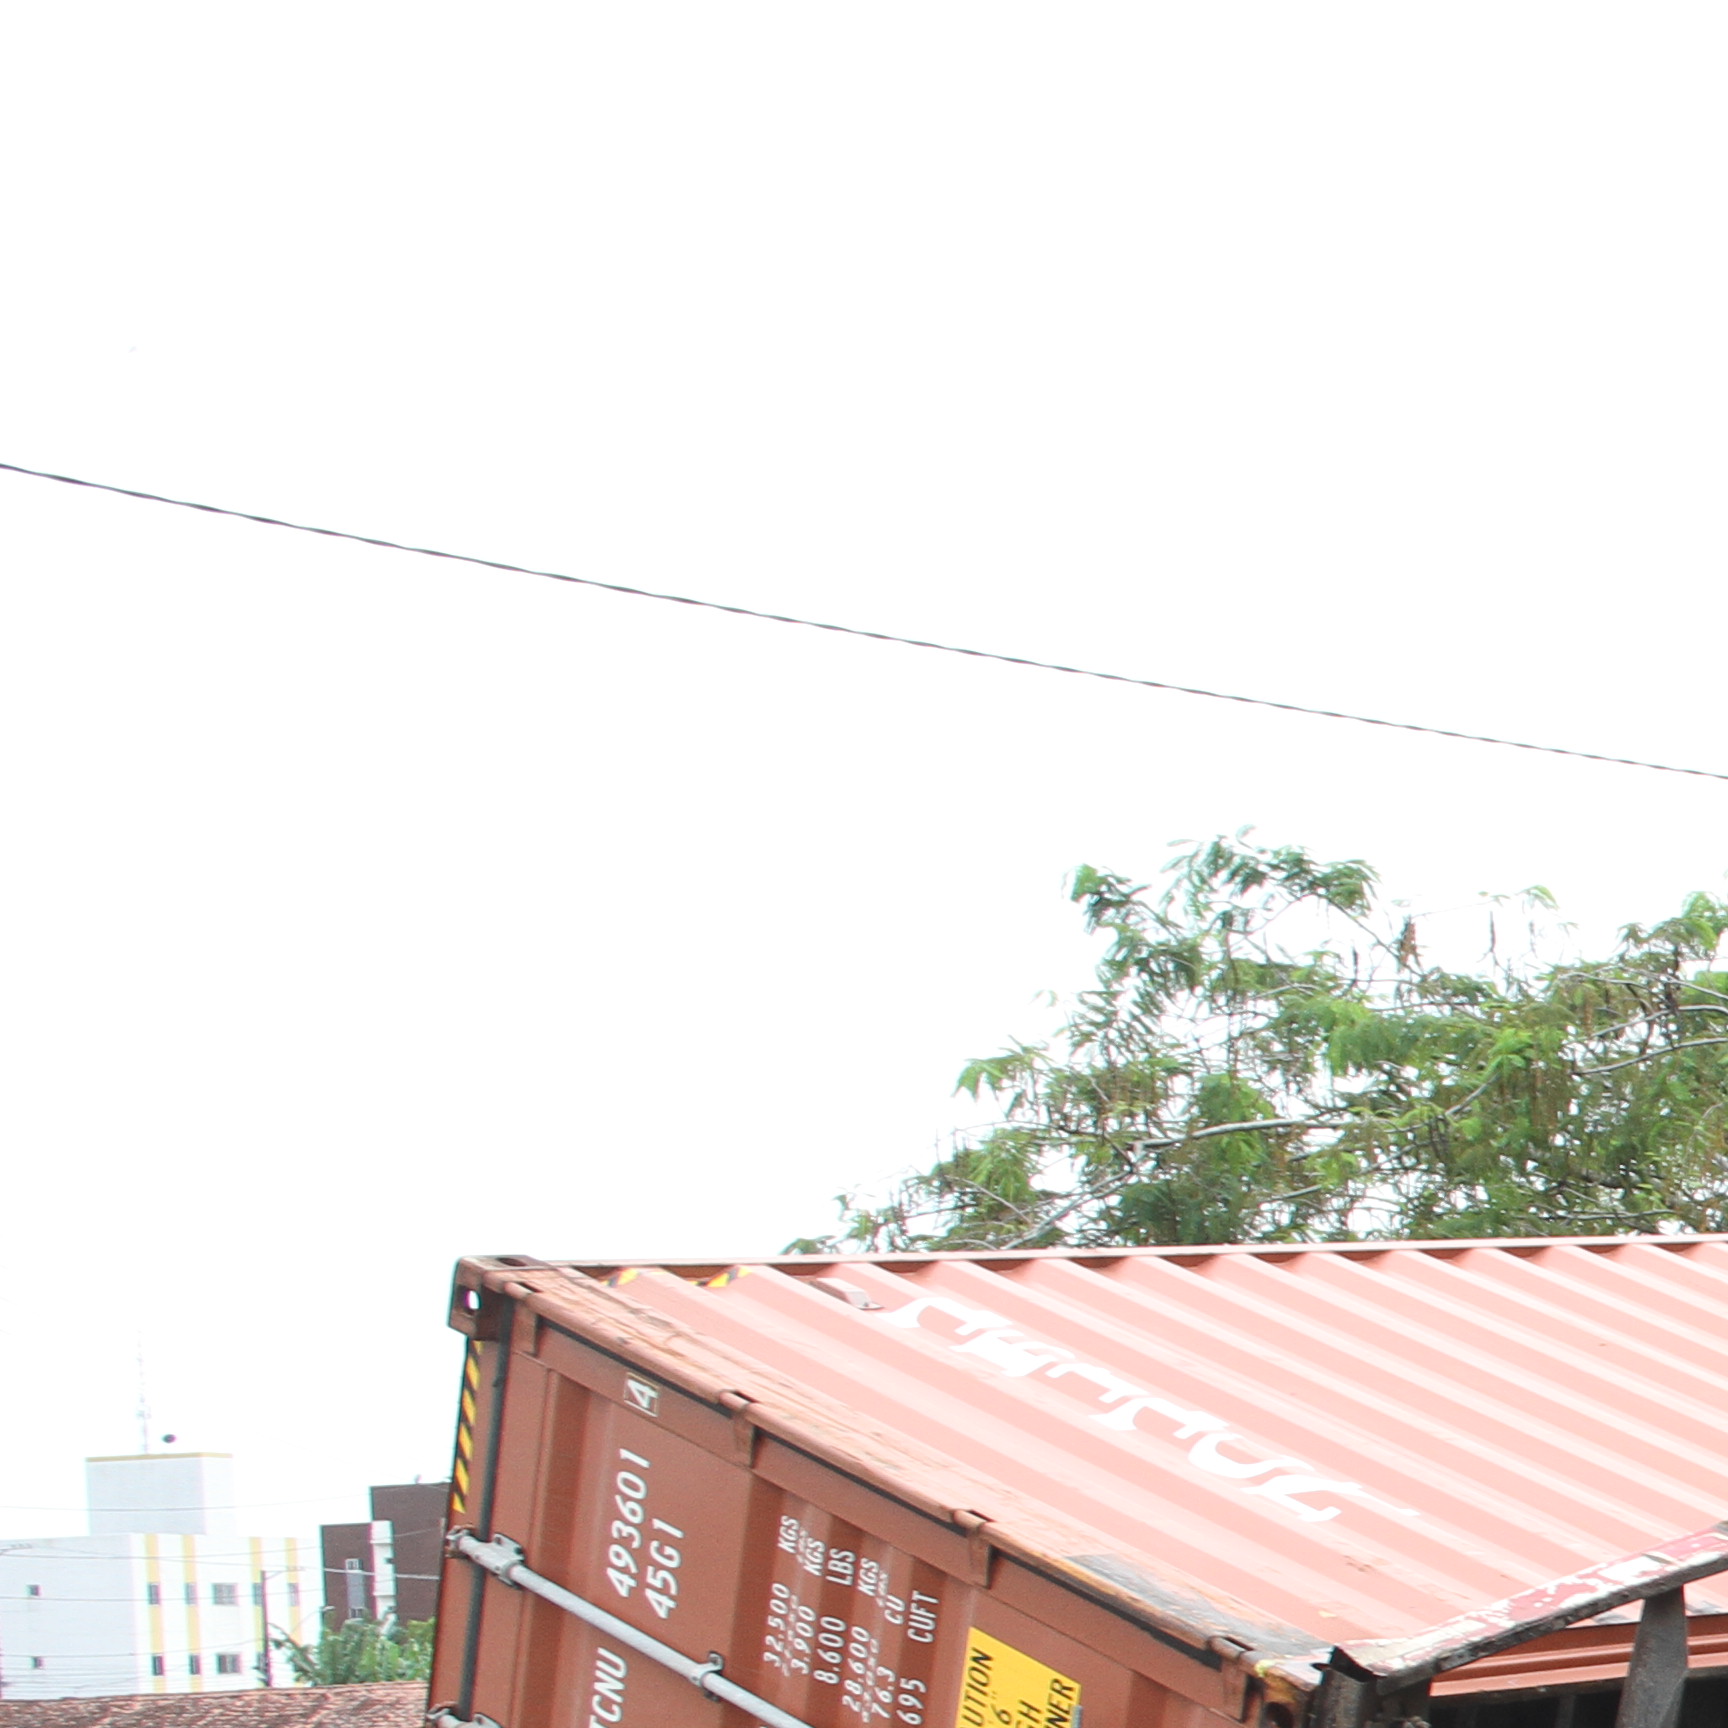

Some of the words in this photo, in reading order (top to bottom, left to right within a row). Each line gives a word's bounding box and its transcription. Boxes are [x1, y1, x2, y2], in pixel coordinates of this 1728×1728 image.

[627, 1377, 658, 1410] 4
[606, 1447, 651, 1598] 493601
[803, 1537, 826, 1576] KGS
[645, 1518, 684, 1619] 45G1
[763, 1582, 791, 1668] 32.500
[777, 1515, 800, 1554] KGS
[826, 1548, 857, 1586] LBS
[790, 1605, 817, 1675] 3.900
[813, 1615, 847, 1685] 8.600
[842, 1625, 871, 1712] 28.600
[857, 1557, 880, 1597] KGS
[907, 1590, 939, 1643] CUFT
[871, 1665, 897, 1719] 76.3
